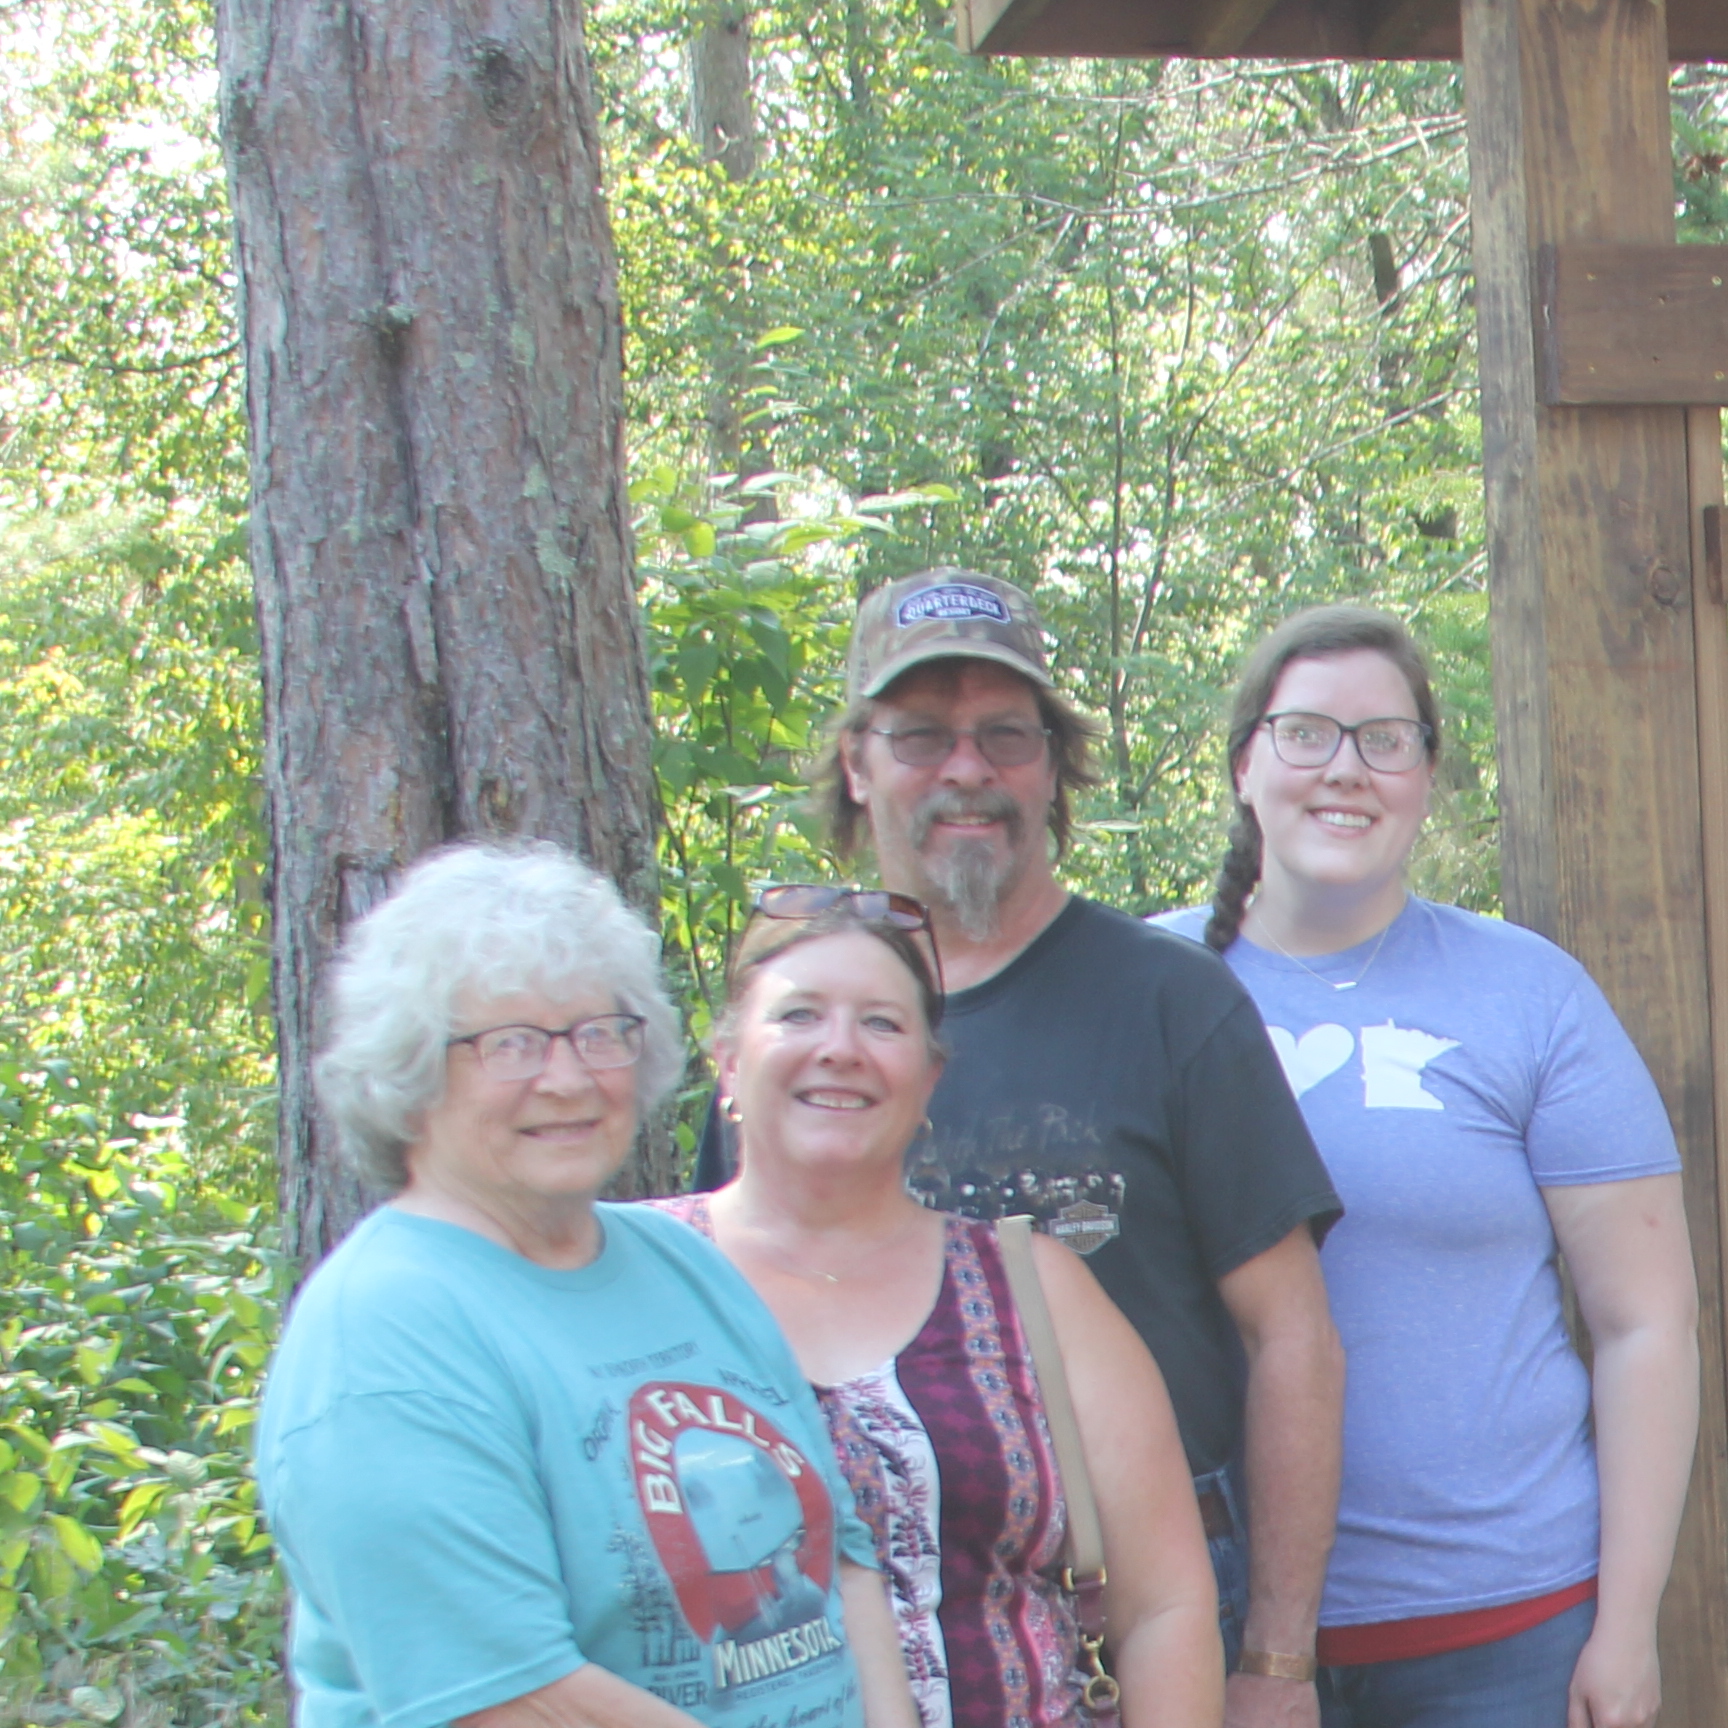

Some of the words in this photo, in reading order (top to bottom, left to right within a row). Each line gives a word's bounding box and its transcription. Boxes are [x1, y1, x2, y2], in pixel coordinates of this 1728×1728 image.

[906, 593, 1002, 619] QUARTERDECK
[634, 1419, 684, 1514] BIG
[647, 1388, 806, 1478] FALLS
[713, 1619, 844, 1689] MINNESOTA
